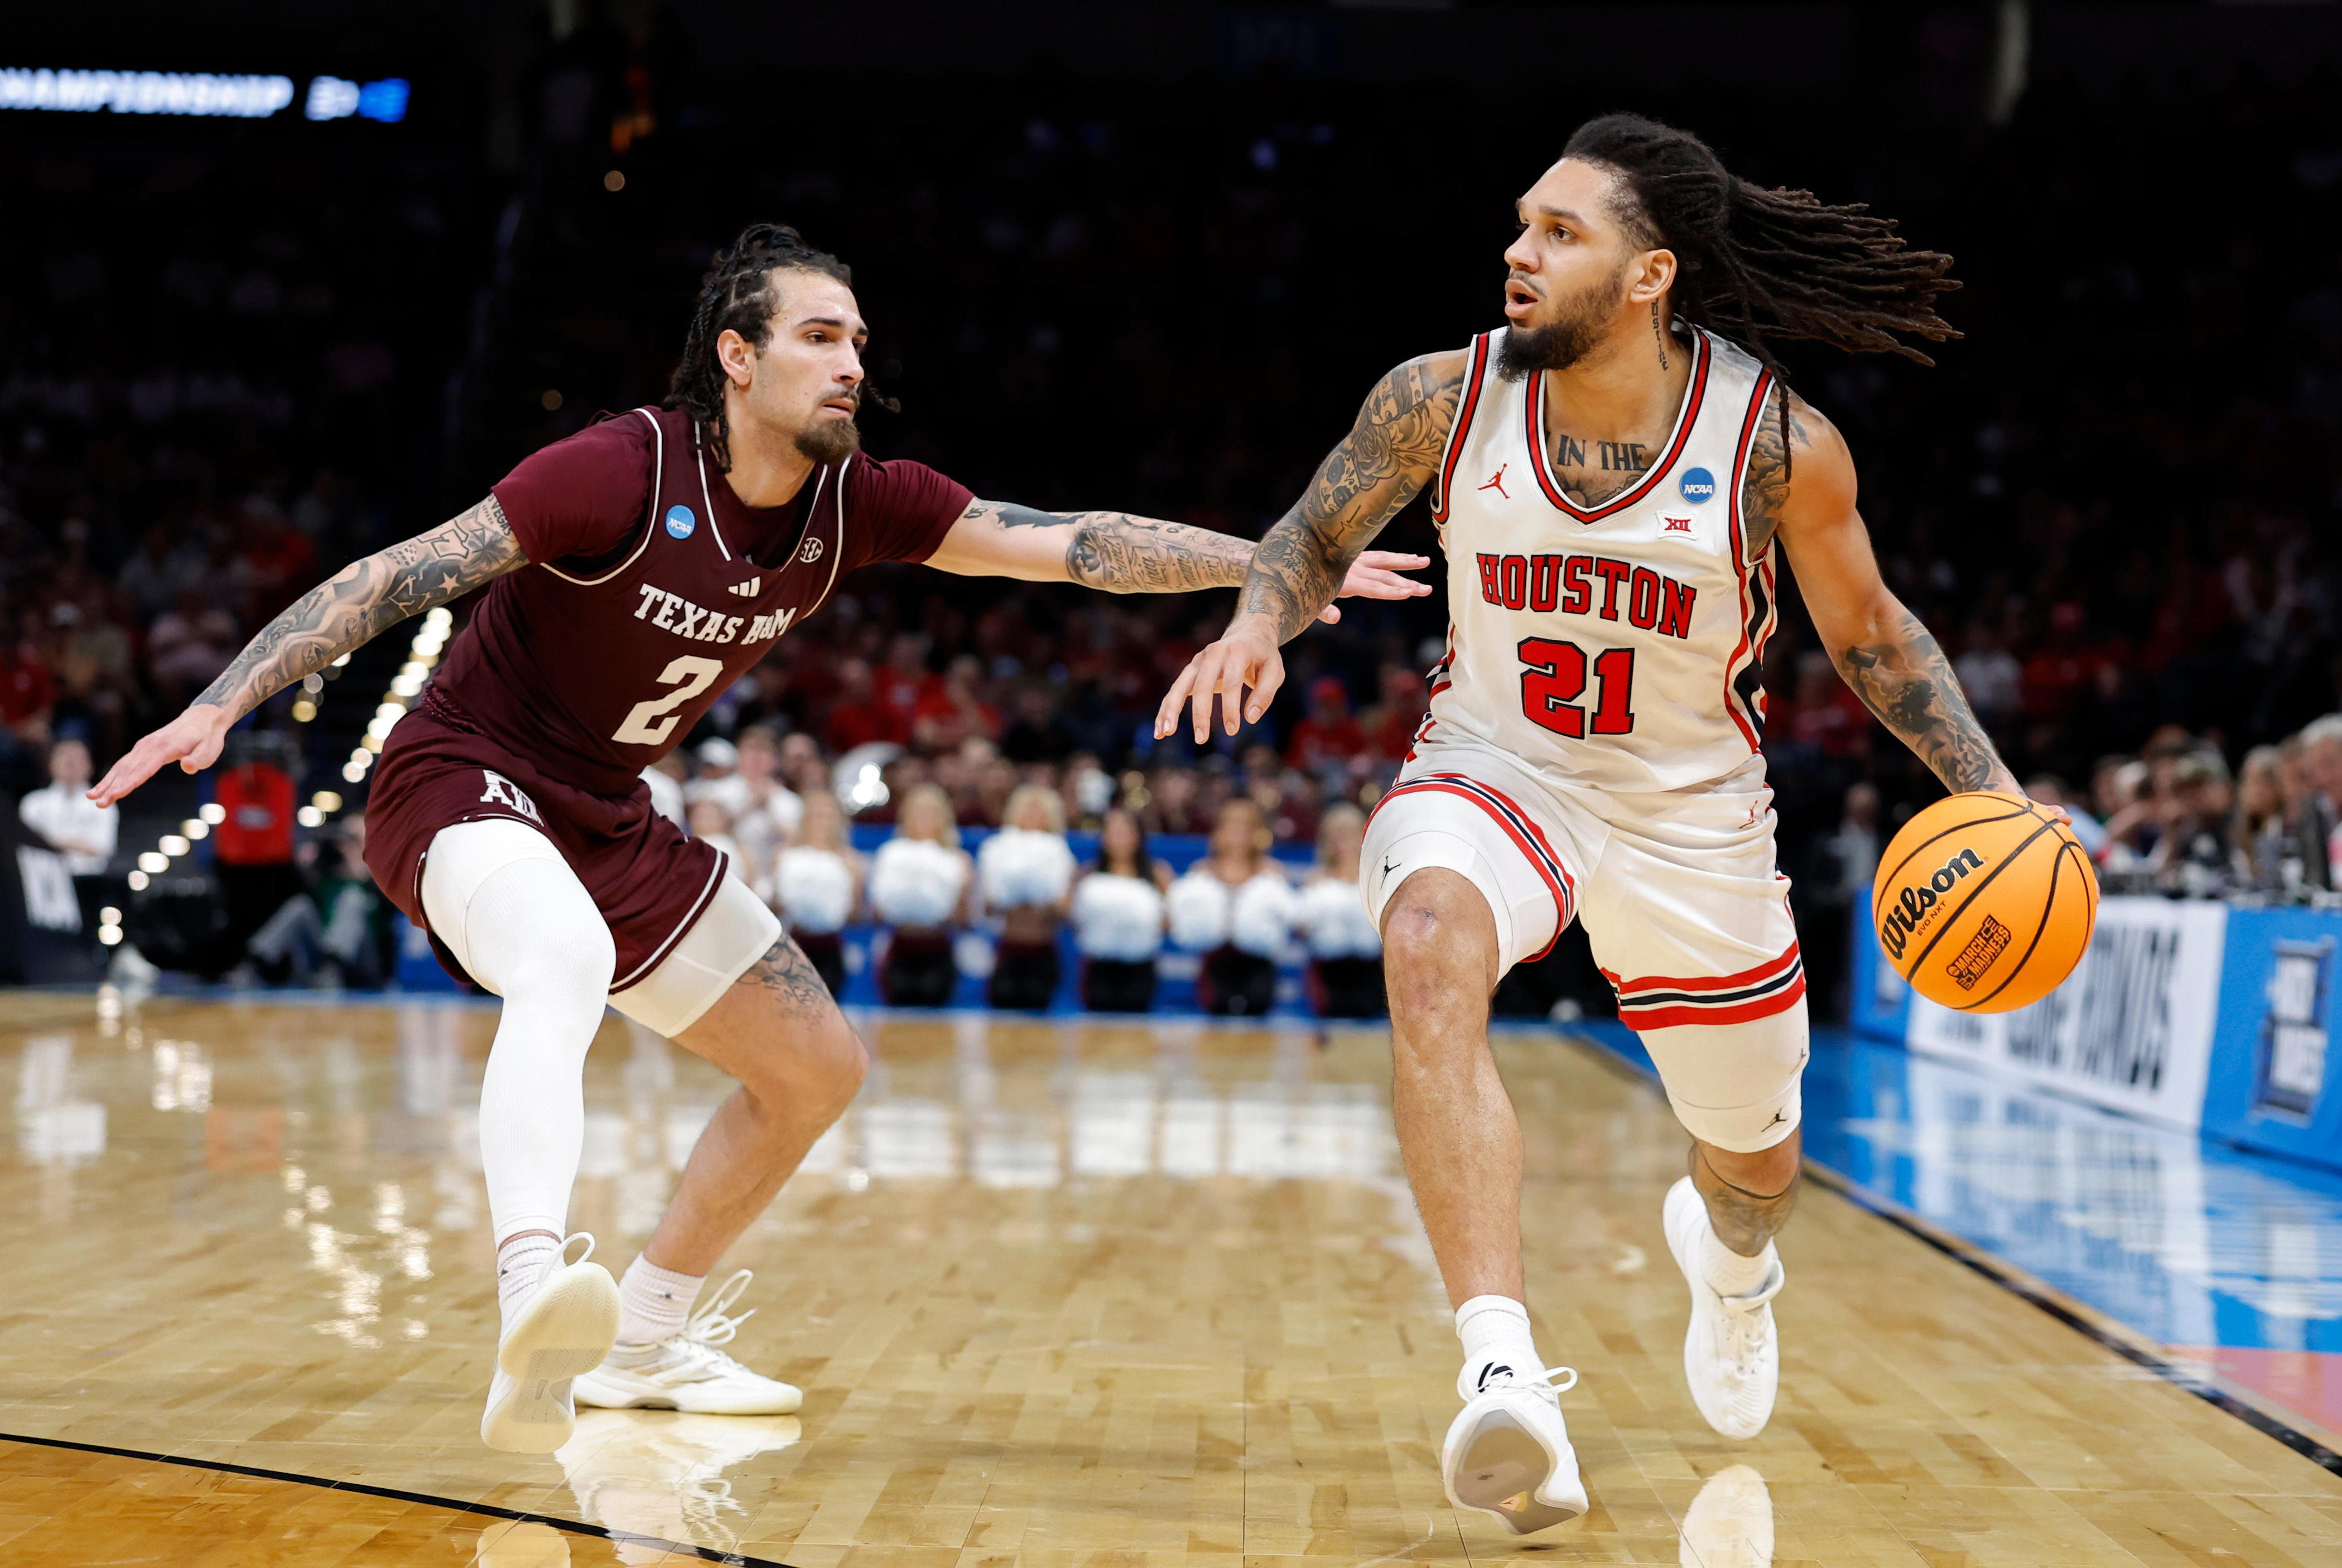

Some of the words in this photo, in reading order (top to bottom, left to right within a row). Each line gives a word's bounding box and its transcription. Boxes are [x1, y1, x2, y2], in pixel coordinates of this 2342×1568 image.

[1557, 435, 1586, 467] IN
[1597, 440, 1649, 471] THE
[1684, 484, 1713, 494] NCAA
[668, 517, 692, 534] NCAA
[634, 583, 744, 643] TEXAS
[740, 607, 797, 645] A&M
[1476, 553, 1697, 639] HOUSTON
[611, 655, 724, 746] 2
[1517, 636, 1635, 740] 21
[1881, 847, 1986, 960] Wilson
[1917, 919, 1931, 936] EVO
[1930, 900, 1946, 919] NXT
[1954, 934, 1987, 971] MARCH
[1968, 926, 2010, 978] MADNESS
